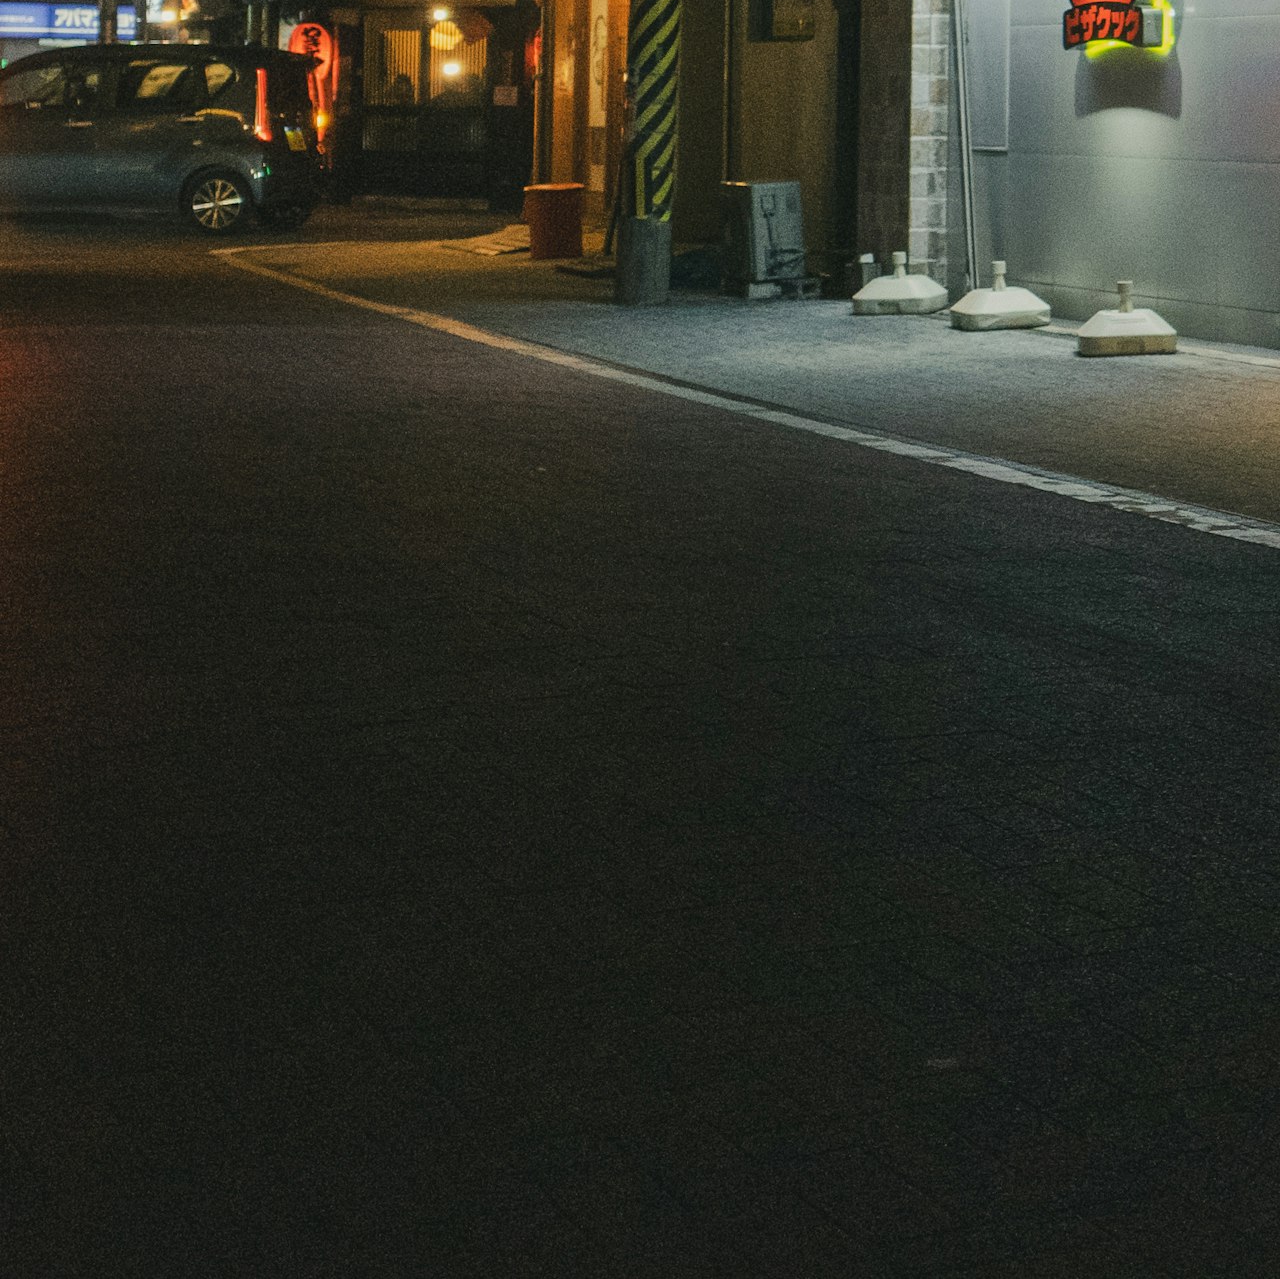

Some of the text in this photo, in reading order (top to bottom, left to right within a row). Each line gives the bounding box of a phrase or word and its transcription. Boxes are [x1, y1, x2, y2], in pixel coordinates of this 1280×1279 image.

[1065, 4, 1140, 44] ピザクック
